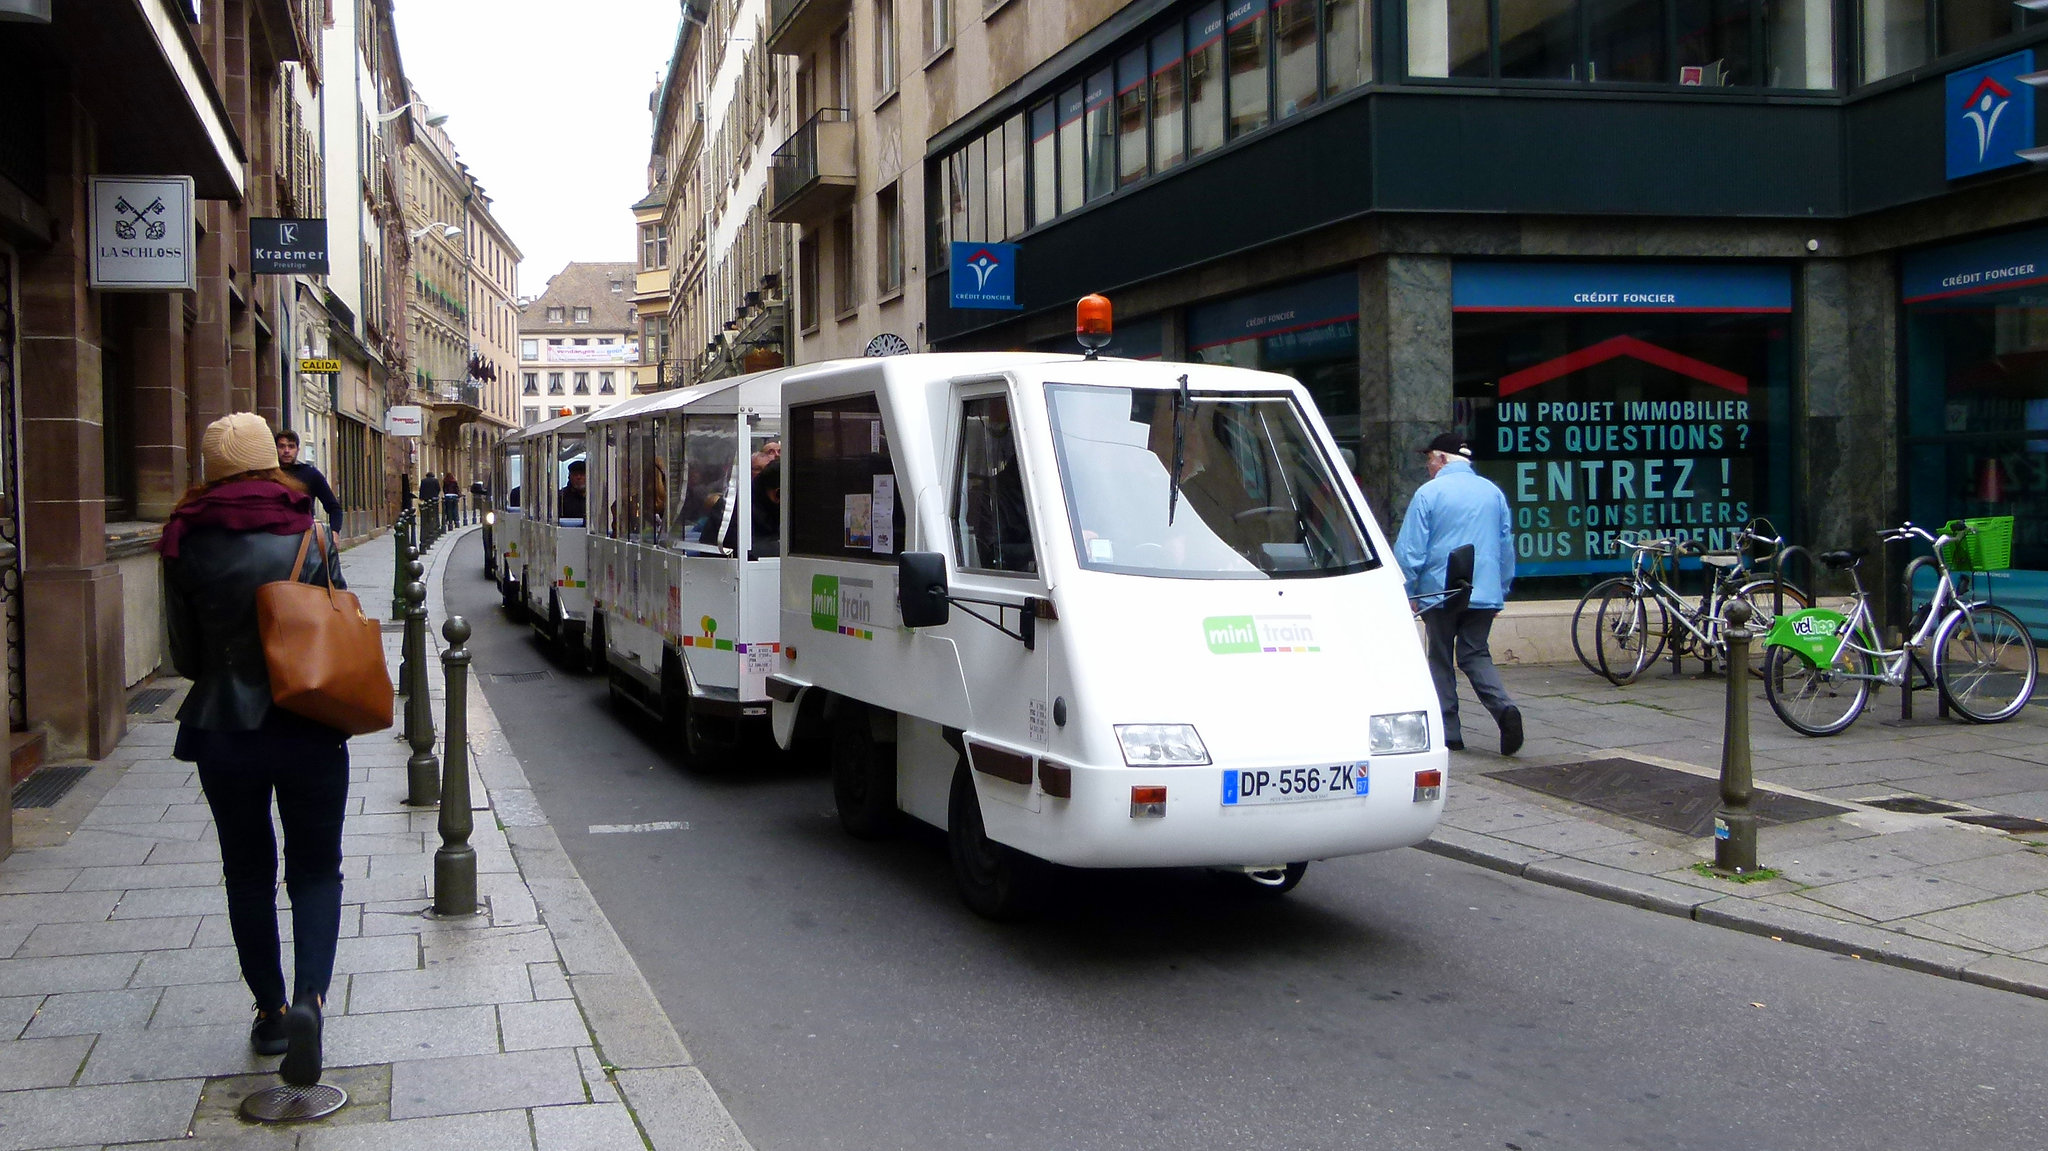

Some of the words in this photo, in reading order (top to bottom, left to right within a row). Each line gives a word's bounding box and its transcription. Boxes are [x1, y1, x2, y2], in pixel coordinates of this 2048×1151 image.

[101, 247, 118, 258] LA
[121, 247, 182, 258] SCHLOSS
[255, 248, 324, 260] Kraemer
[273, 261, 307, 269] Prestige
[1942, 272, 1981, 287] CRÉDIT
[1985, 264, 2034, 281] FONCIER
[1574, 292, 1618, 303] CRÉDIT
[1623, 293, 1675, 303] FONCIER
[1246, 316, 1267, 328] CRÉDIT
[1268, 310, 1295, 323] FONCIER
[302, 361, 339, 370] CALIDA
[1498, 402, 1527, 422] UN
[1538, 401, 1614, 421] PROJET
[1624, 400, 1749, 420] IMMOBILIER
[1498, 426, 1551, 452] DES
[1565, 424, 1723, 452] QUESTIONS
[1736, 423, 1749, 449] ?
[1517, 458, 1694, 502] ENTREZ
[1721, 458, 1730, 497] !
[1511, 506, 1550, 529] OS
[1567, 502, 1748, 527] CONSEILLERS
[1511, 531, 1571, 558] OUS
[813, 588, 837, 617] mini
[842, 590, 871, 623] train
[1209, 624, 1254, 646] mini
[1263, 622, 1314, 642] train
[1241, 765, 1354, 797] DP-556-ZK
[1357, 780, 1367, 793] 67
